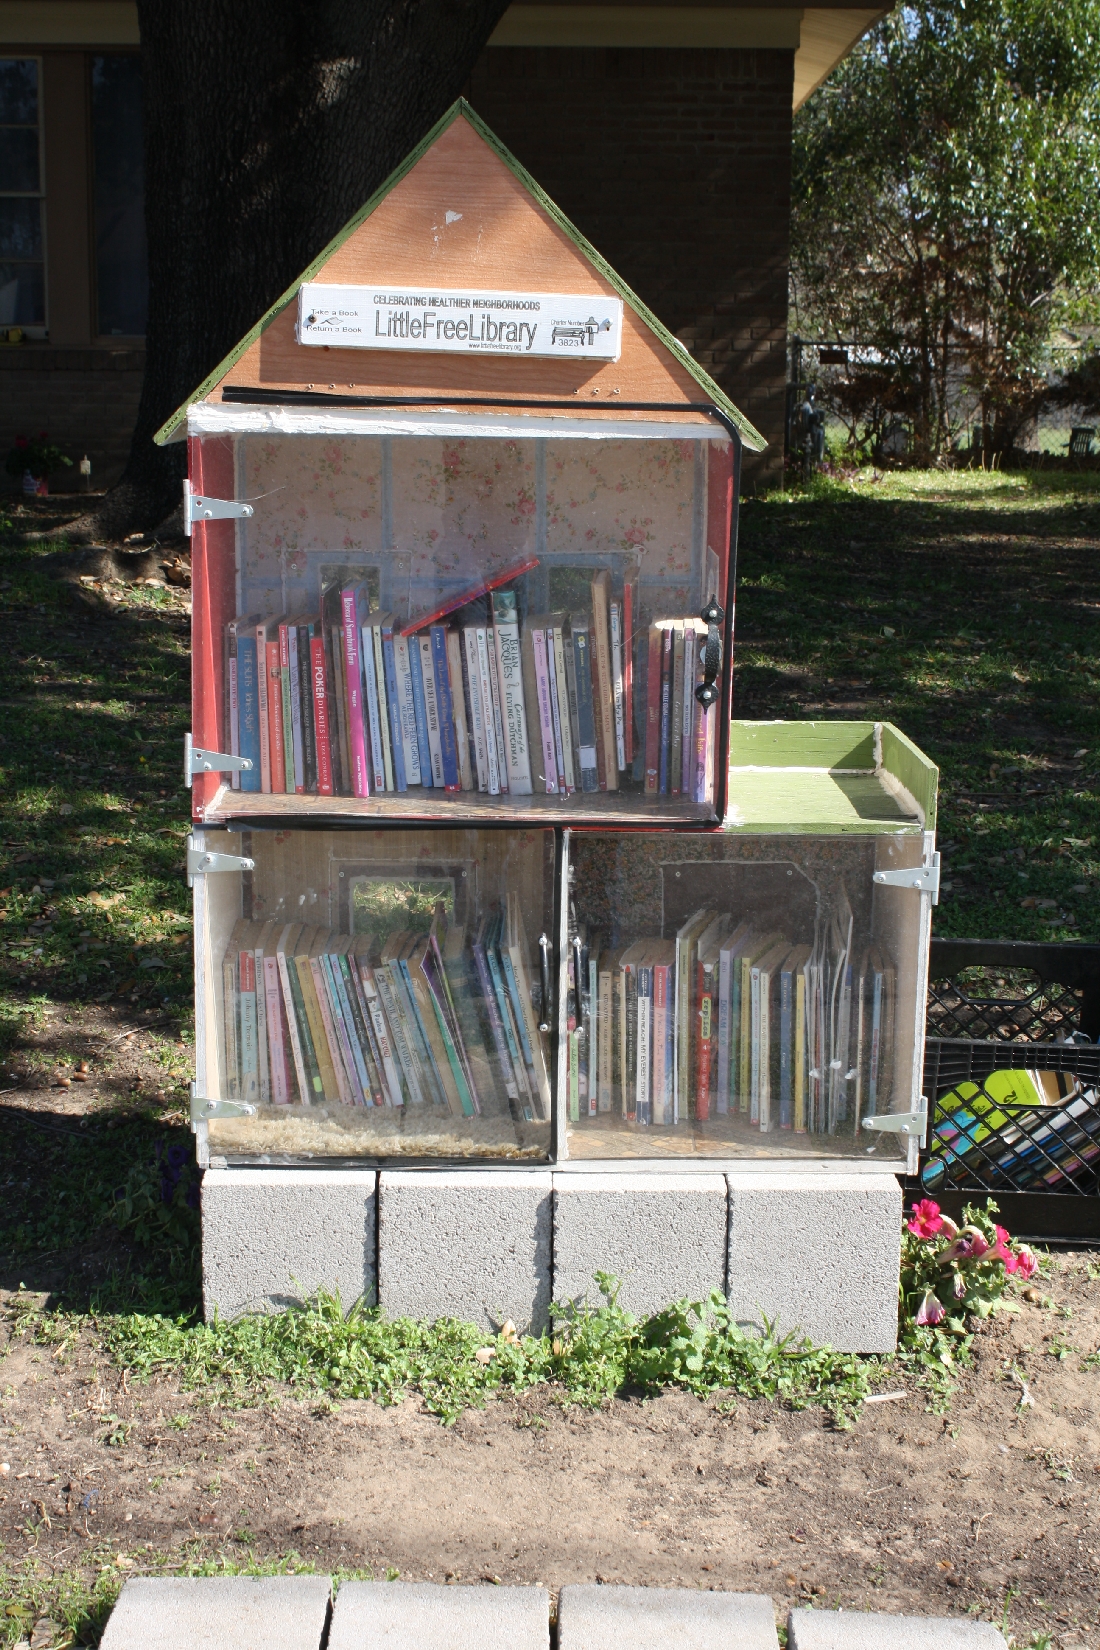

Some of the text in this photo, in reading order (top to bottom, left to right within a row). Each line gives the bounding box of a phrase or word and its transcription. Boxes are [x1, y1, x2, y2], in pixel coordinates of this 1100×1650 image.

[310, 308, 330, 316] Take
[338, 309, 359, 317] Book
[373, 294, 541, 311] CELEBRATING HEALTHIER NEIGHBORHOODS
[306, 324, 333, 333] Return
[342, 325, 362, 333] Book
[375, 309, 538, 350] LittleFreeLibrary
[558, 338, 579, 347] 3823
[344, 597, 353, 617] Rebecca
[345, 623, 356, 652] Sunnybrook
[244, 650, 252, 665] THE
[347, 652, 357, 666] Farm
[498, 630, 519, 679] BRIAN JACQUES
[314, 666, 325, 699] POKER
[404, 672, 412, 698] WHERE
[406, 698, 414, 713] THE
[472, 687, 481, 716] INVISIBLE
[317, 700, 326, 735] DIARIES
[474, 716, 482, 732] MAN
[506, 692, 519, 767] FLYING DUTCHMAN
[513, 703, 524, 739] Castaways
[409, 727, 417, 744] FERN
[673, 733, 681, 748] May
[321, 757, 329, 783] CONRAD
[411, 745, 420, 771] GROWS
[244, 997, 253, 1023] Johnny
[701, 999, 710, 1037] replica
[720, 1000, 729, 1047] DREAM BOY
[245, 1024, 254, 1052] Tremain
[640, 1044, 647, 1055] MY
[401, 1044, 413, 1068] WALKER
